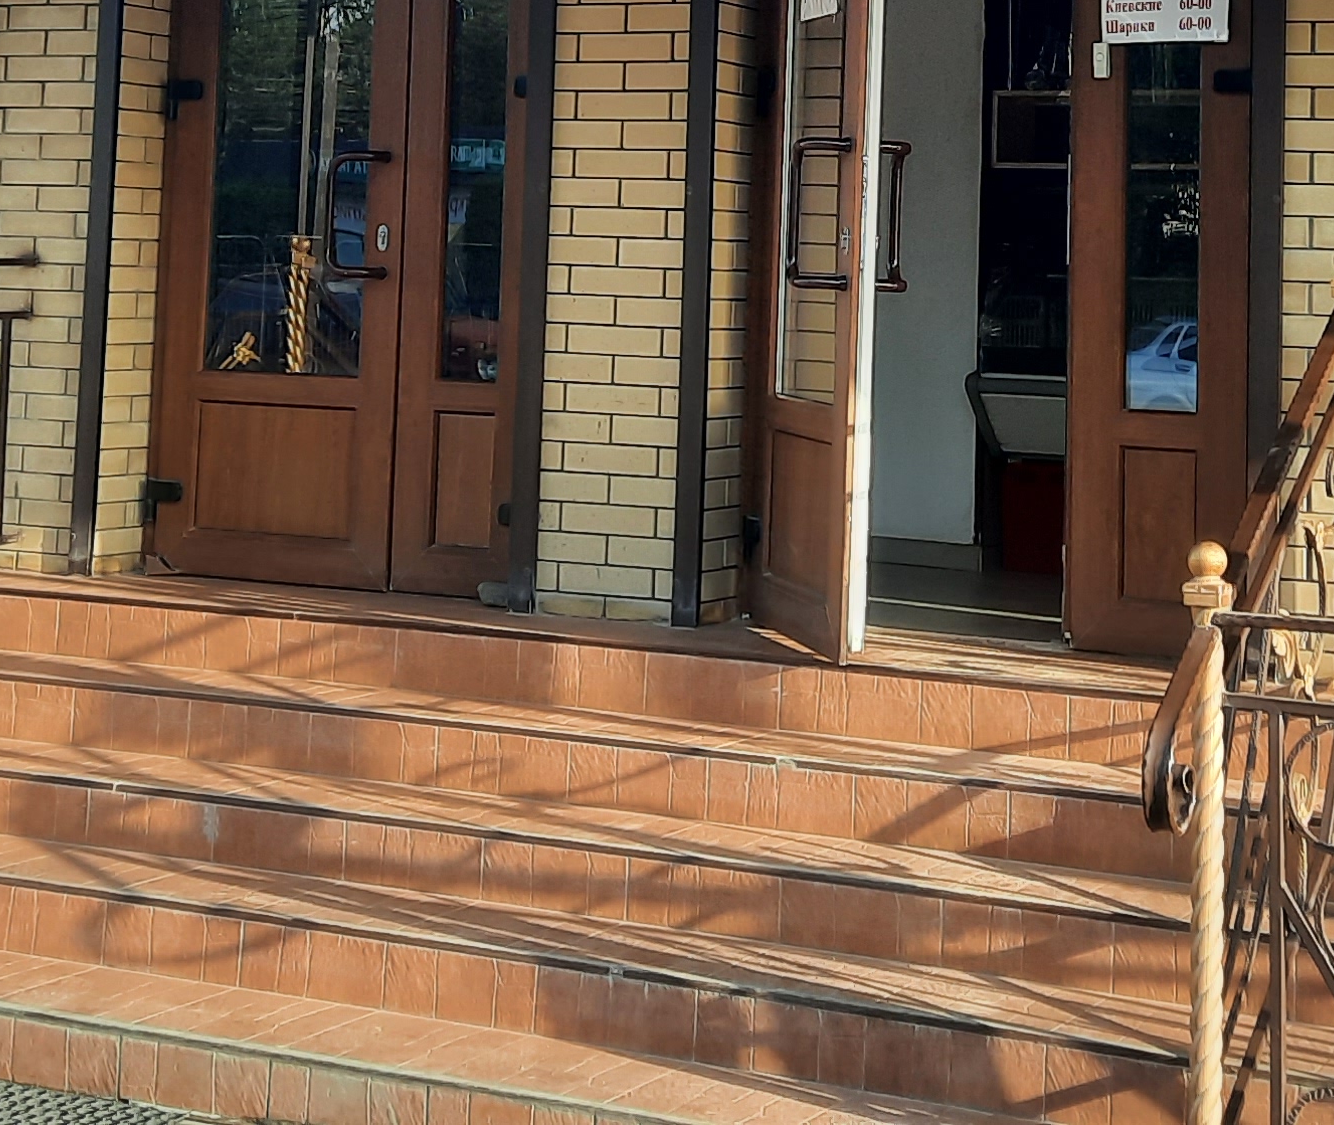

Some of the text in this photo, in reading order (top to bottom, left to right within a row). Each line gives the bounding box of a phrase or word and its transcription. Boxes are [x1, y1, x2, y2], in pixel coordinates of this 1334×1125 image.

[1105, 0, 1163, 14] Киевские
[1105, 16, 1211, 36] Шарики 60-00
